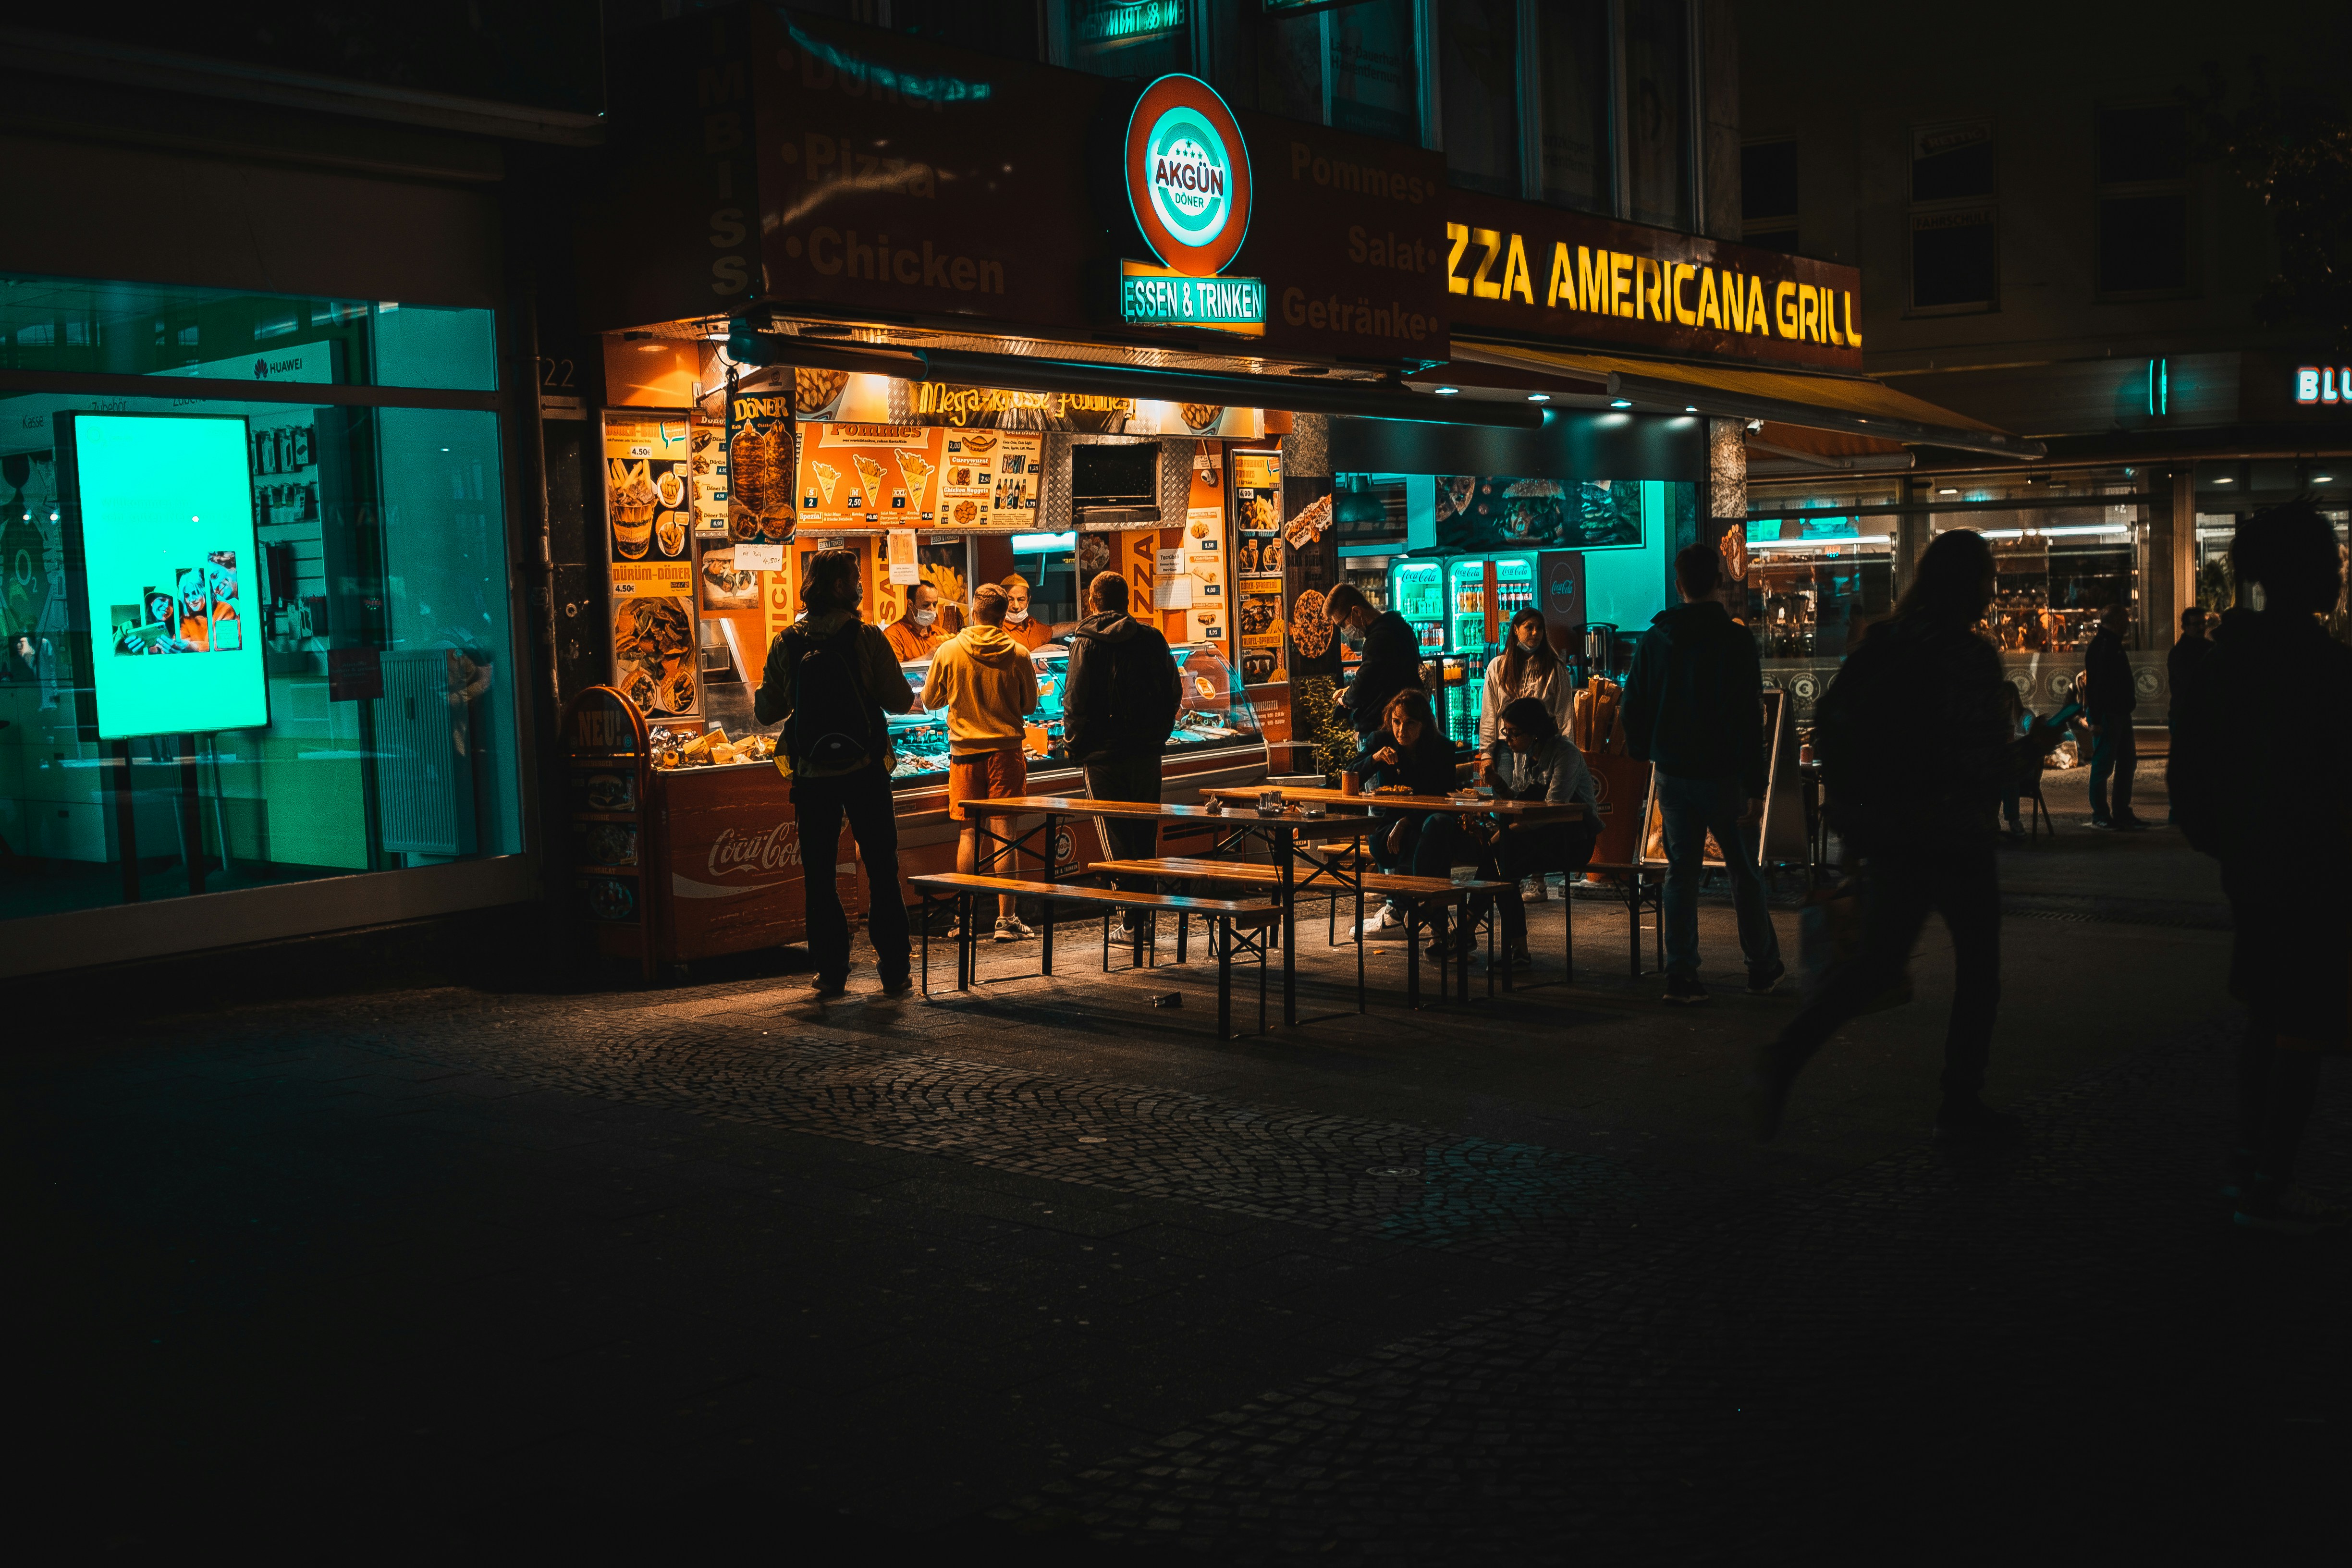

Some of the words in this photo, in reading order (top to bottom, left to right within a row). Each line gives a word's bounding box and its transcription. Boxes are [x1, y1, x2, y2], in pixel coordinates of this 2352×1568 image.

[805, 132, 935, 199] Pizza
[1155, 159, 1224, 196] AKGÜN
[1290, 141, 1423, 205] Pommes
[1175, 192, 1204, 208] DÖNER
[1916, 211, 1991, 229] FAHRSCHULE
[808, 226, 1005, 294] Chicken
[1348, 225, 1427, 273] Salat
[1125, 281, 1178, 318] ESSEN
[1182, 282, 1193, 318] &
[1196, 282, 1263, 320] TRINKEN
[1547, 242, 1770, 336] AMERICANA
[1776, 280, 1862, 348] GRILL
[1282, 287, 1426, 341] Getränke
[270, 357, 302, 373] HUAWEI
[545, 358, 576, 388] 22
[22, 414, 44, 429] Kasse
[734, 397, 789, 422] DÖNER
[952, 456, 989, 465] Currywurst
[1236, 470, 1255, 478] POMMES
[808, 498, 813, 507] 2
[848, 498, 861, 507] 2,50
[800, 513, 822, 521] Spezial
[612, 564, 690, 581] DÜRÜM-DÖNER
[577, 710, 622, 747] NEU!
